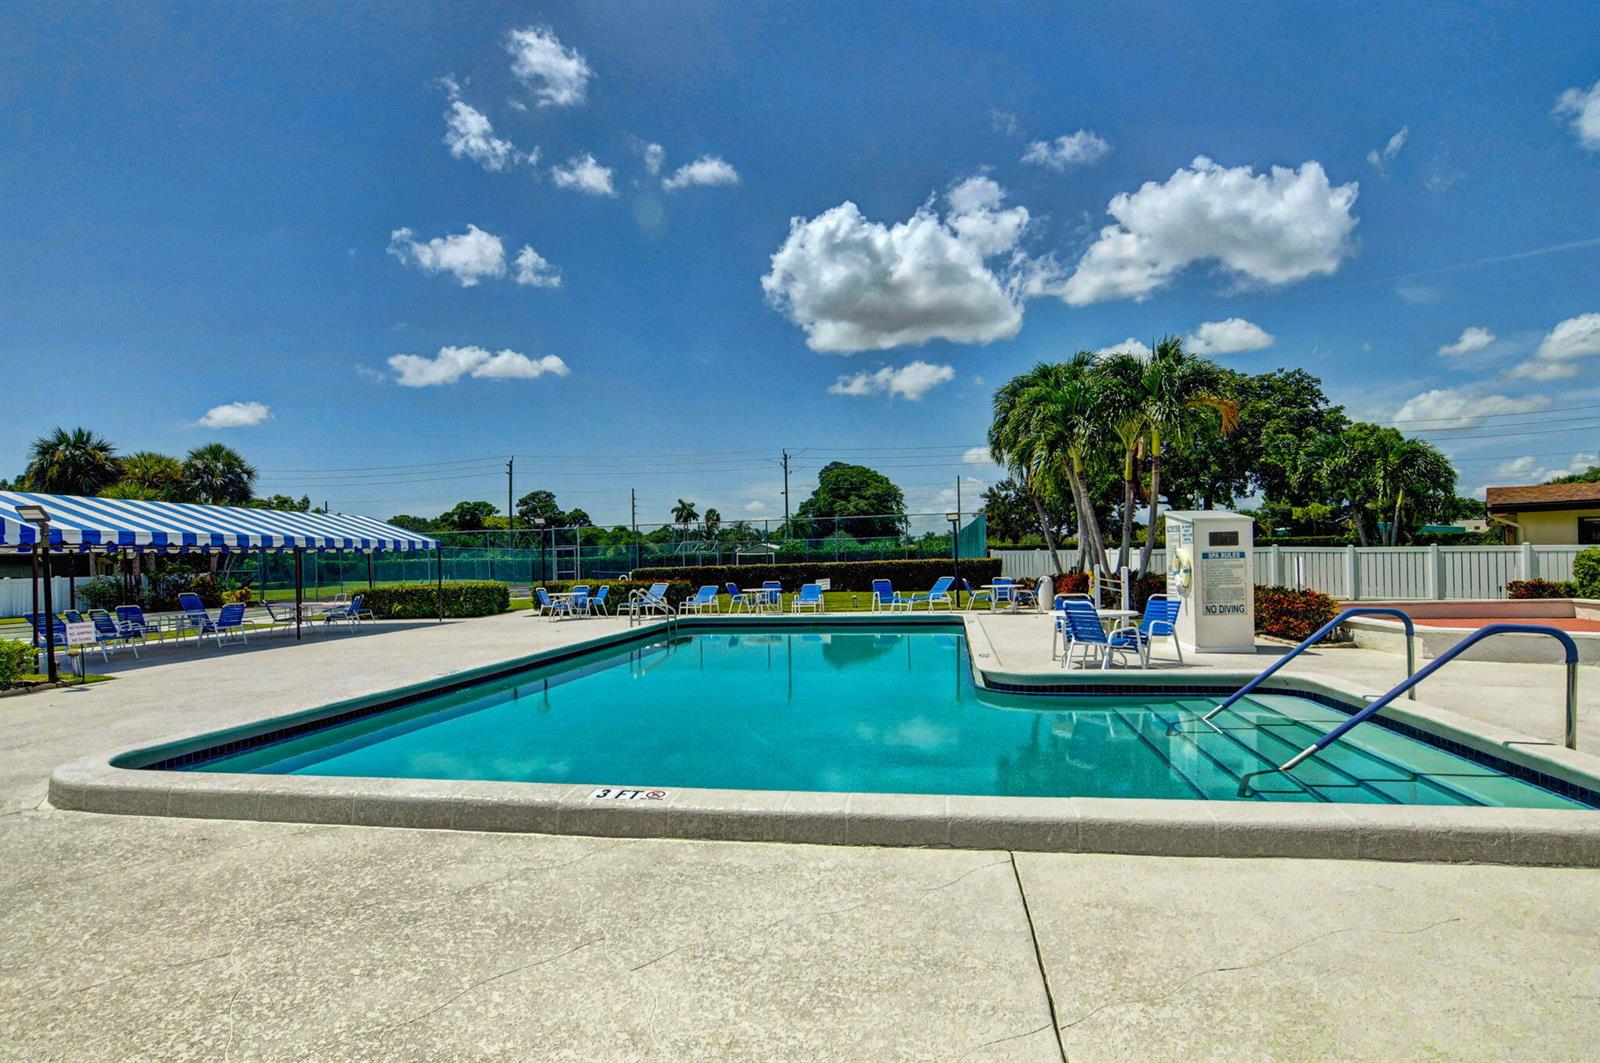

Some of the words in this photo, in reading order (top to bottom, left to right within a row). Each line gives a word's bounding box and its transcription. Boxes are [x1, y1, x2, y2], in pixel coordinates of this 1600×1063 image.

[1208, 551, 1220, 559] SPA
[1205, 604, 1217, 614] NO
[1218, 604, 1246, 614] DIVING
[596, 789, 611, 798] 3
[614, 789, 645, 799] FT
